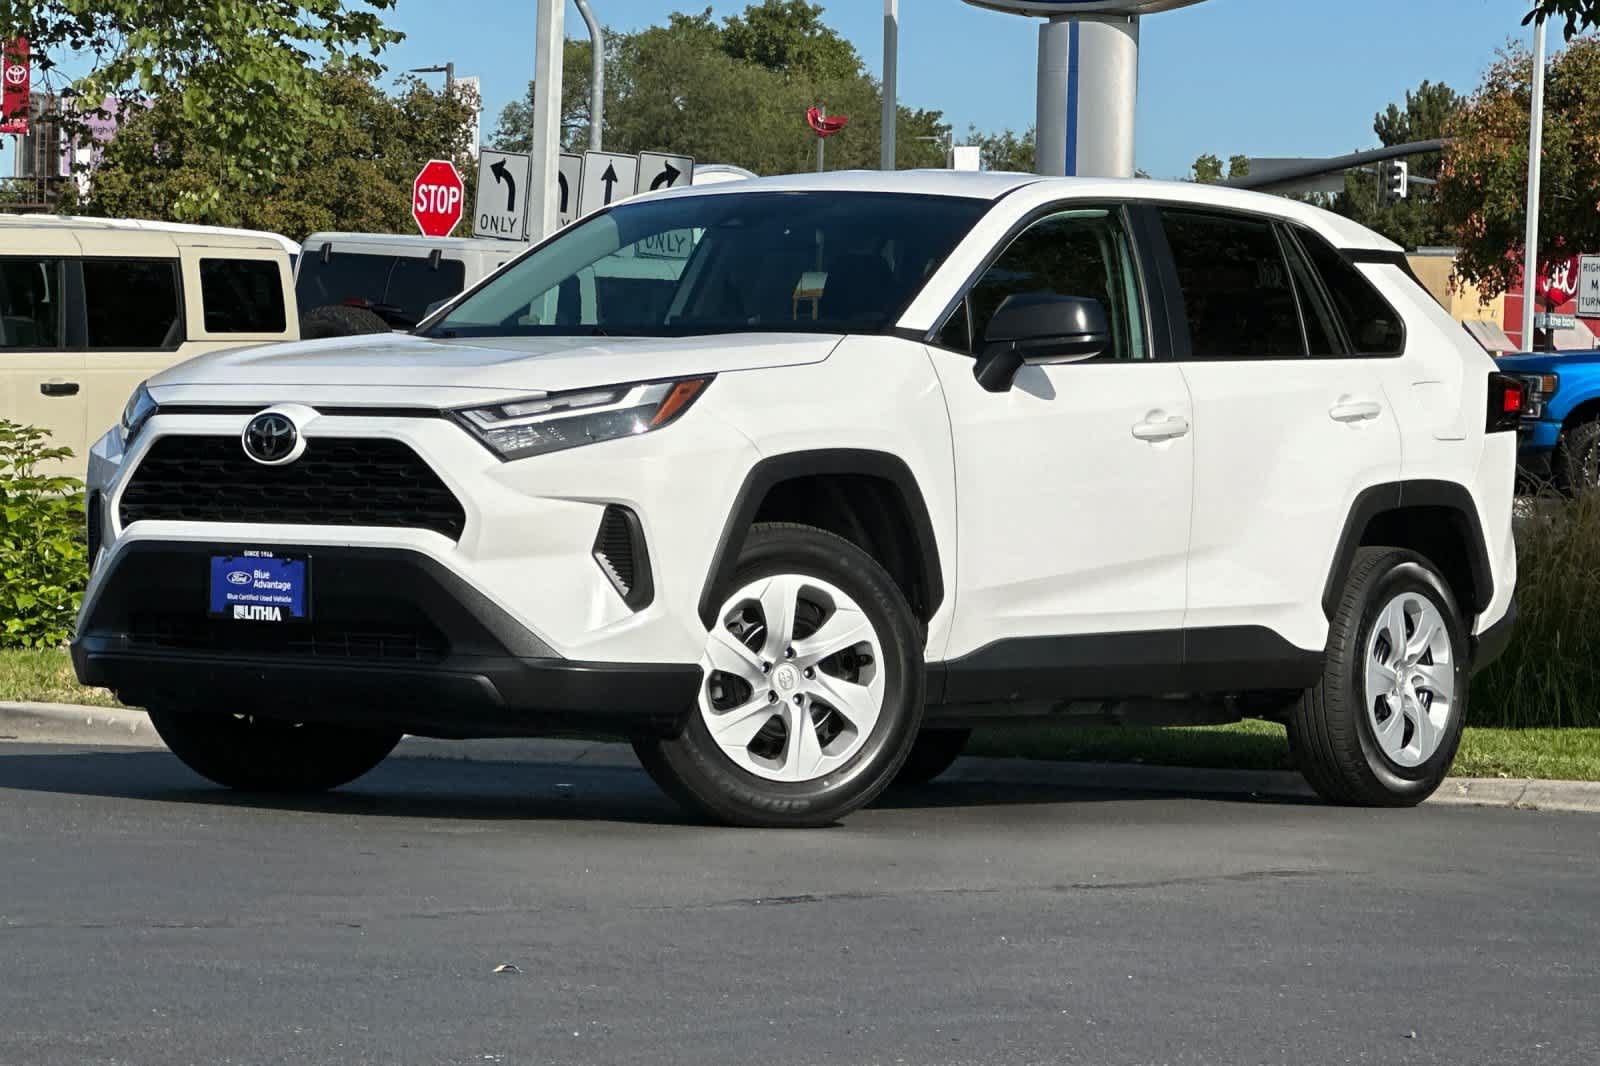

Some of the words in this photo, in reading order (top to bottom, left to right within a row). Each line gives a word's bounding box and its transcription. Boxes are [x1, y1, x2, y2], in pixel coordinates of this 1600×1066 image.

[416, 184, 460, 215] STOP
[480, 213, 517, 233] ONLY
[645, 232, 685, 253] ONLY
[231, 573, 248, 583] Ford
[253, 569, 270, 579] Blue
[253, 580, 292, 591] Advantage
[239, 593, 259, 601] Certified
[260, 594, 273, 602] Used
[244, 605, 282, 621] LITHIA
